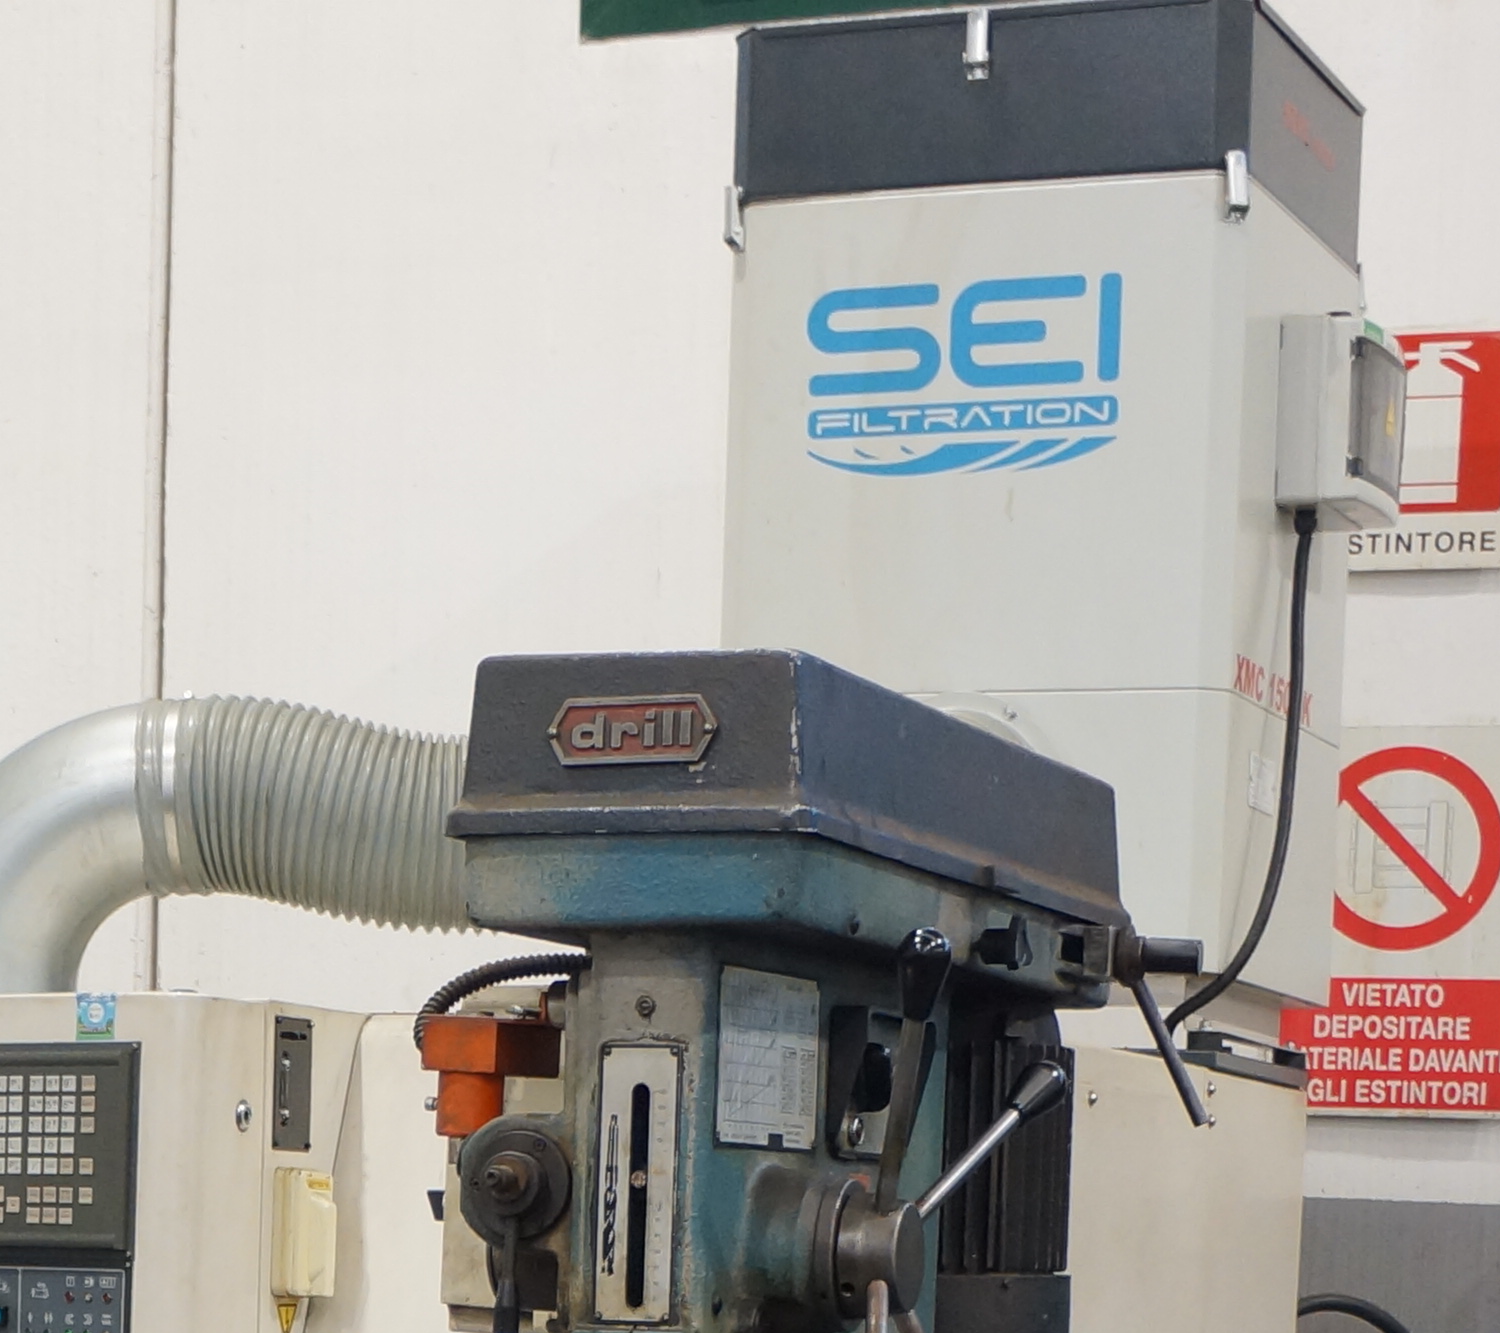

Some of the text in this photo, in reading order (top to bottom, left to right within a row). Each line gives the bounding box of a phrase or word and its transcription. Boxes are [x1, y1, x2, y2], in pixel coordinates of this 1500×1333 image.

[807, 272, 1122, 397] SEI
[815, 400, 1110, 436] FILTRATION
[1348, 530, 1497, 555] STINTORE
[1233, 653, 1266, 702] XMC
[571, 710, 693, 749] drill
[1341, 982, 1446, 1008] VIETATO
[1312, 1014, 1472, 1041] DEPOSITARE
[1300, 1046, 1403, 1072] ATERIALE
[1306, 1077, 1488, 1107] GLI ESTINTORI
